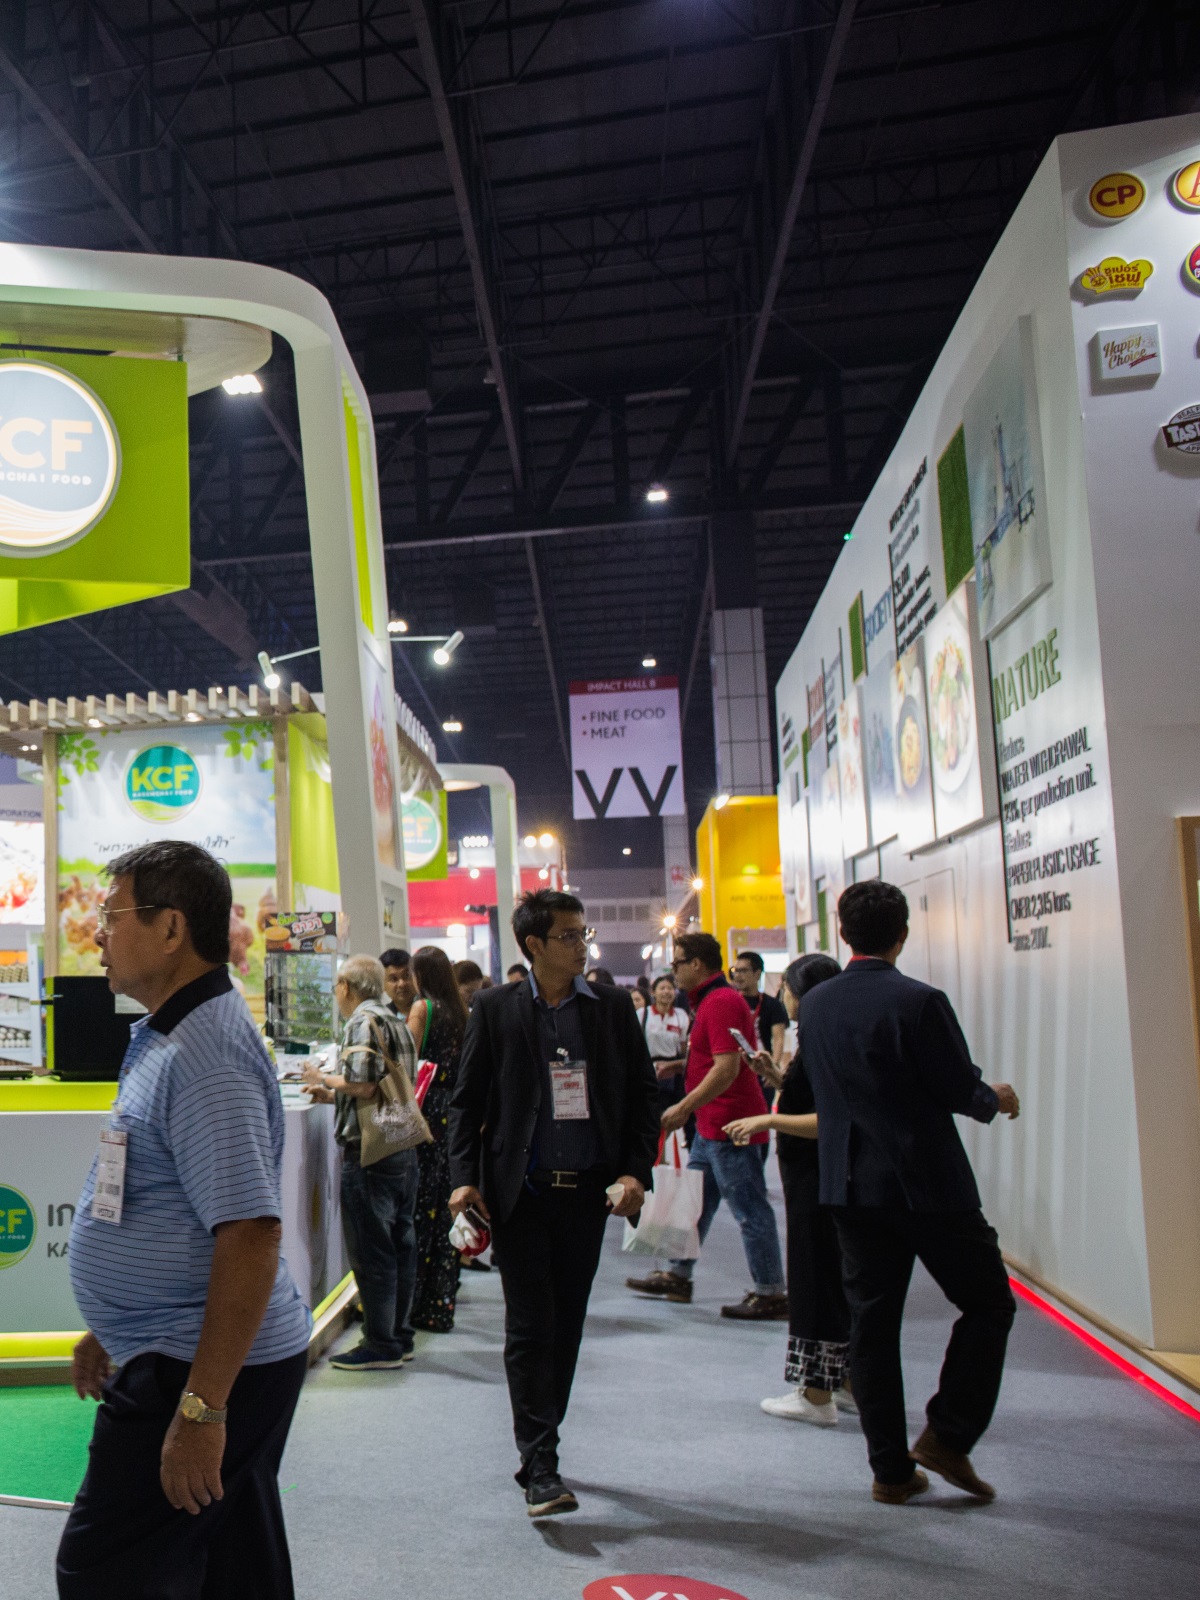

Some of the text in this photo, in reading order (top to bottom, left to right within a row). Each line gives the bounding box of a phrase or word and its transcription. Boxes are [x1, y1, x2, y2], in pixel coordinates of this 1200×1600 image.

[1096, 184, 1137, 207] CP
[1103, 335, 1142, 358] Happy
[1108, 348, 1147, 370] Choice
[51, 474, 93, 485] FOOD
[587, 681, 621, 691] IMPACT
[624, 680, 647, 689] HALL
[993, 627, 1062, 724] NATURE
[590, 707, 666, 722] FINE FOOD
[591, 726, 627, 738] MEAT
[1002, 726, 1092, 793] WATER WITHDRAWAL
[132, 765, 194, 792] KCF
[1034, 774, 1075, 816] production
[1033, 849, 1066, 881] PLASTIC
[1066, 837, 1102, 872] USAGE
[1011, 896, 1031, 921] OVER
[1052, 891, 1072, 914] tons
